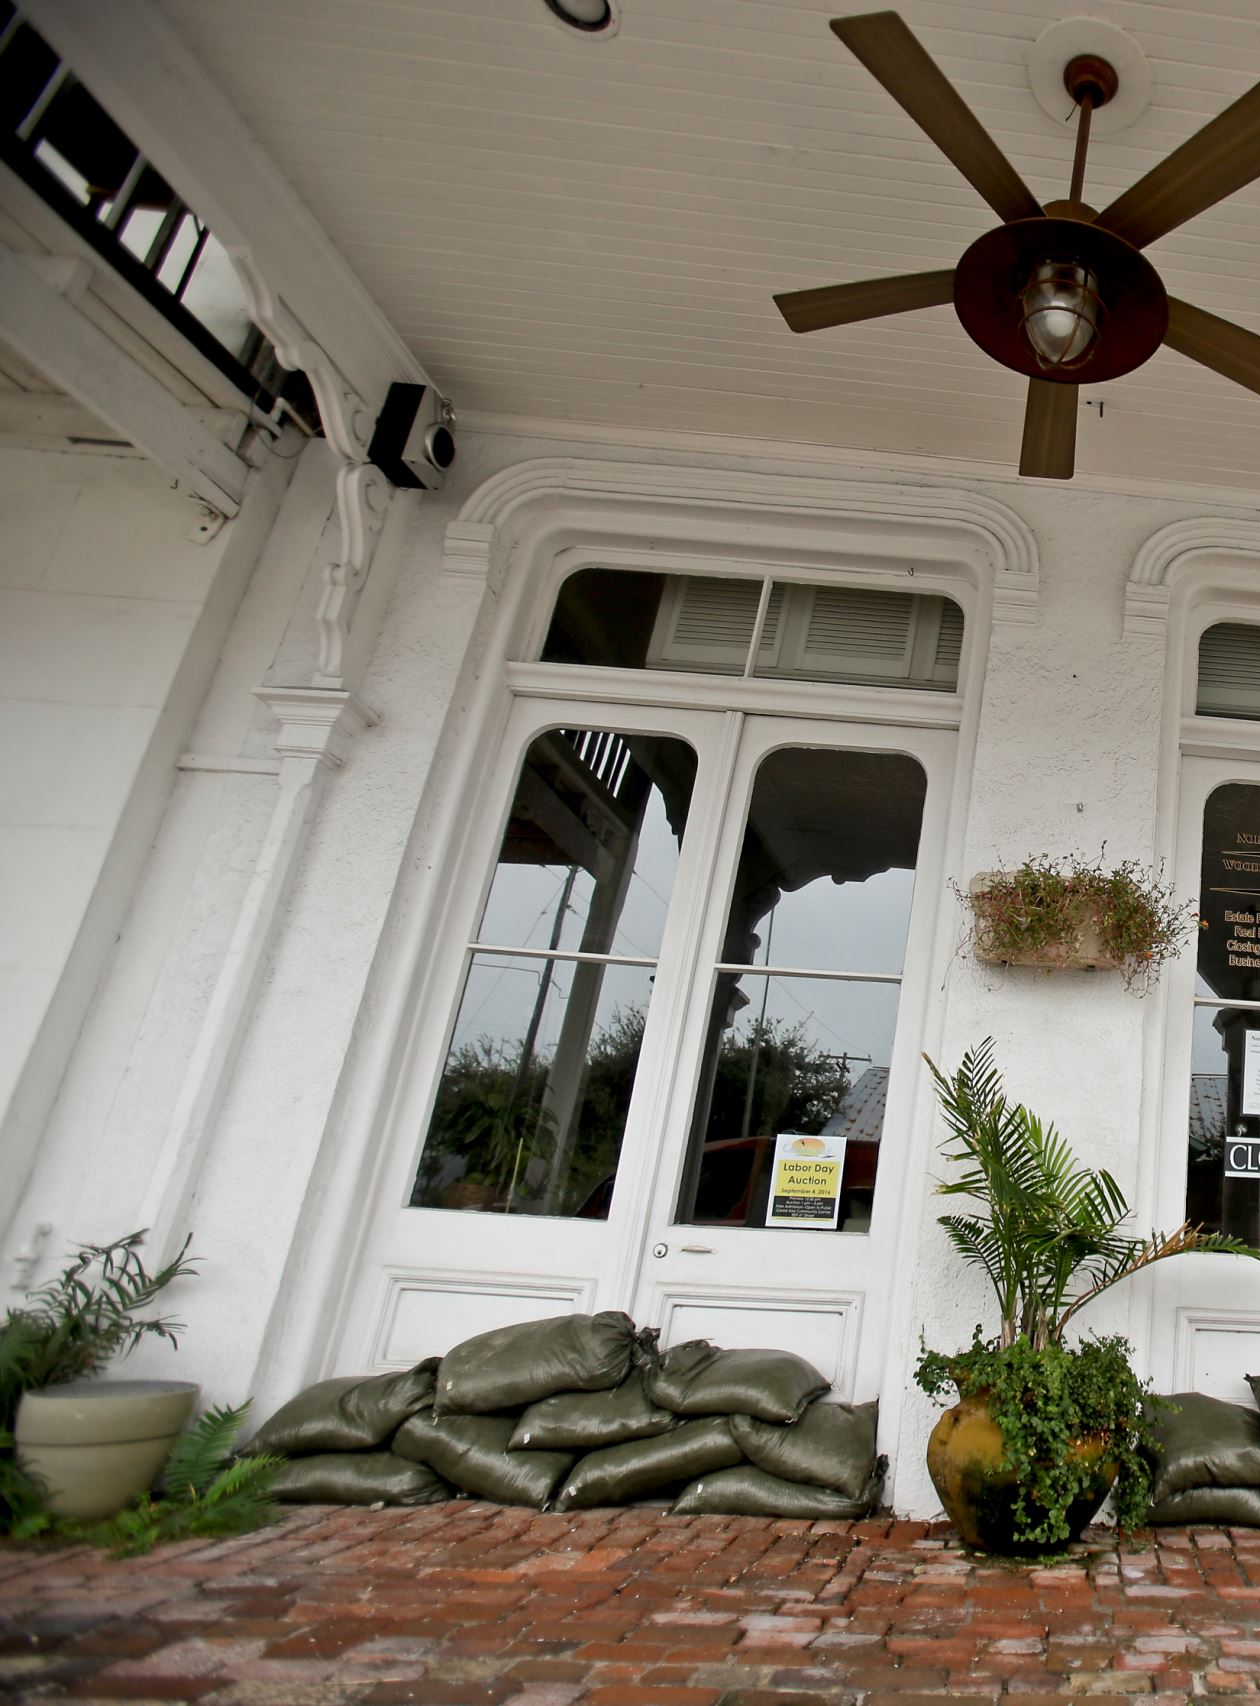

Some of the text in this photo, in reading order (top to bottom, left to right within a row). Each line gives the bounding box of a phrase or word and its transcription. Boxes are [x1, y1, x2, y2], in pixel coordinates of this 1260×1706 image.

[1224, 910, 1255, 924] Estate
[1234, 925, 1256, 938] Real
[783, 1162, 835, 1174] Labor Day
[788, 1175, 827, 1185] Auction
